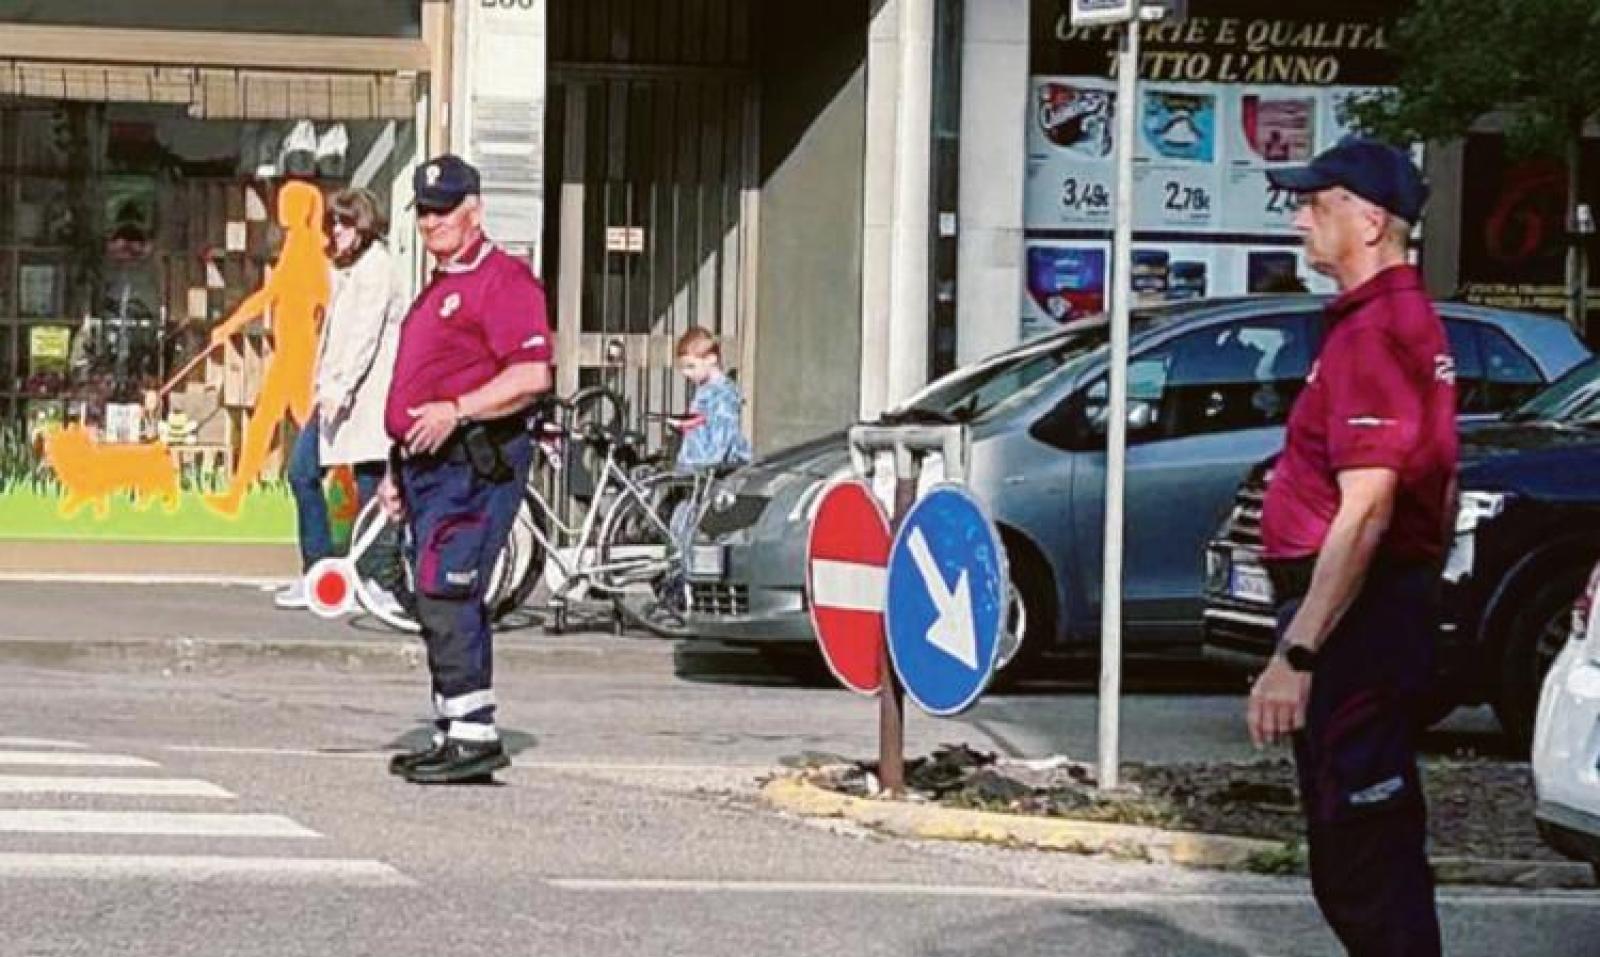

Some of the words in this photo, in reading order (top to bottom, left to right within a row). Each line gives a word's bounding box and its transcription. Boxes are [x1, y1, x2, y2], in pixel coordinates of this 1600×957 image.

[1214, 18, 1240, 45] E
[1106, 50, 1211, 79] TTTO
[1217, 52, 1340, 84] L'ANNO
